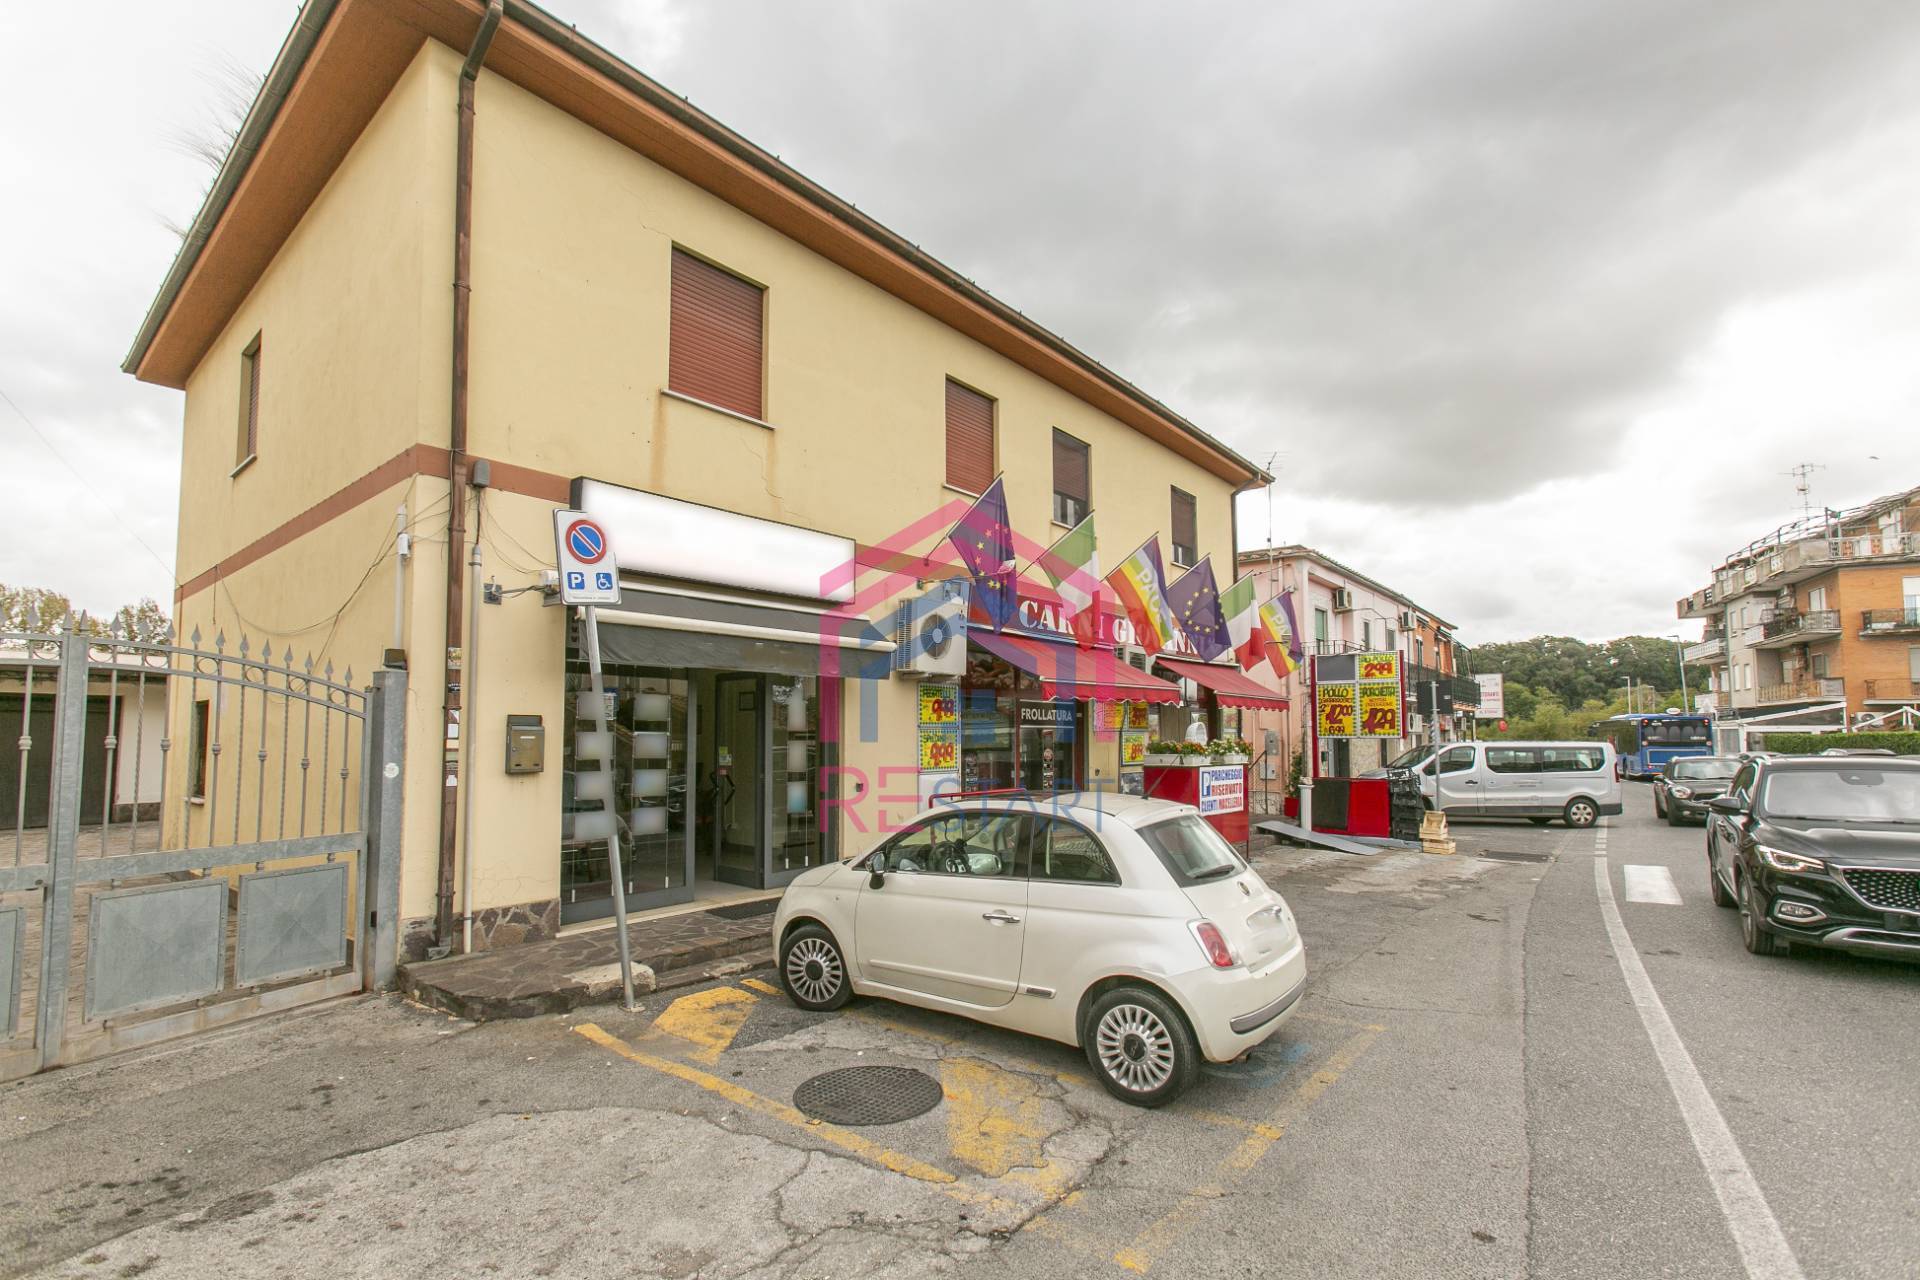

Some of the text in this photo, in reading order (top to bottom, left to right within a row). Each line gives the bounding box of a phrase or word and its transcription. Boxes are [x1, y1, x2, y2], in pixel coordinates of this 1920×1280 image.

[571, 574, 582, 588] P
[1021, 708, 1073, 721] FROLLATURA
[1211, 768, 1242, 781] PARCHEGGIO
[1211, 782, 1242, 796] RISERVATO
